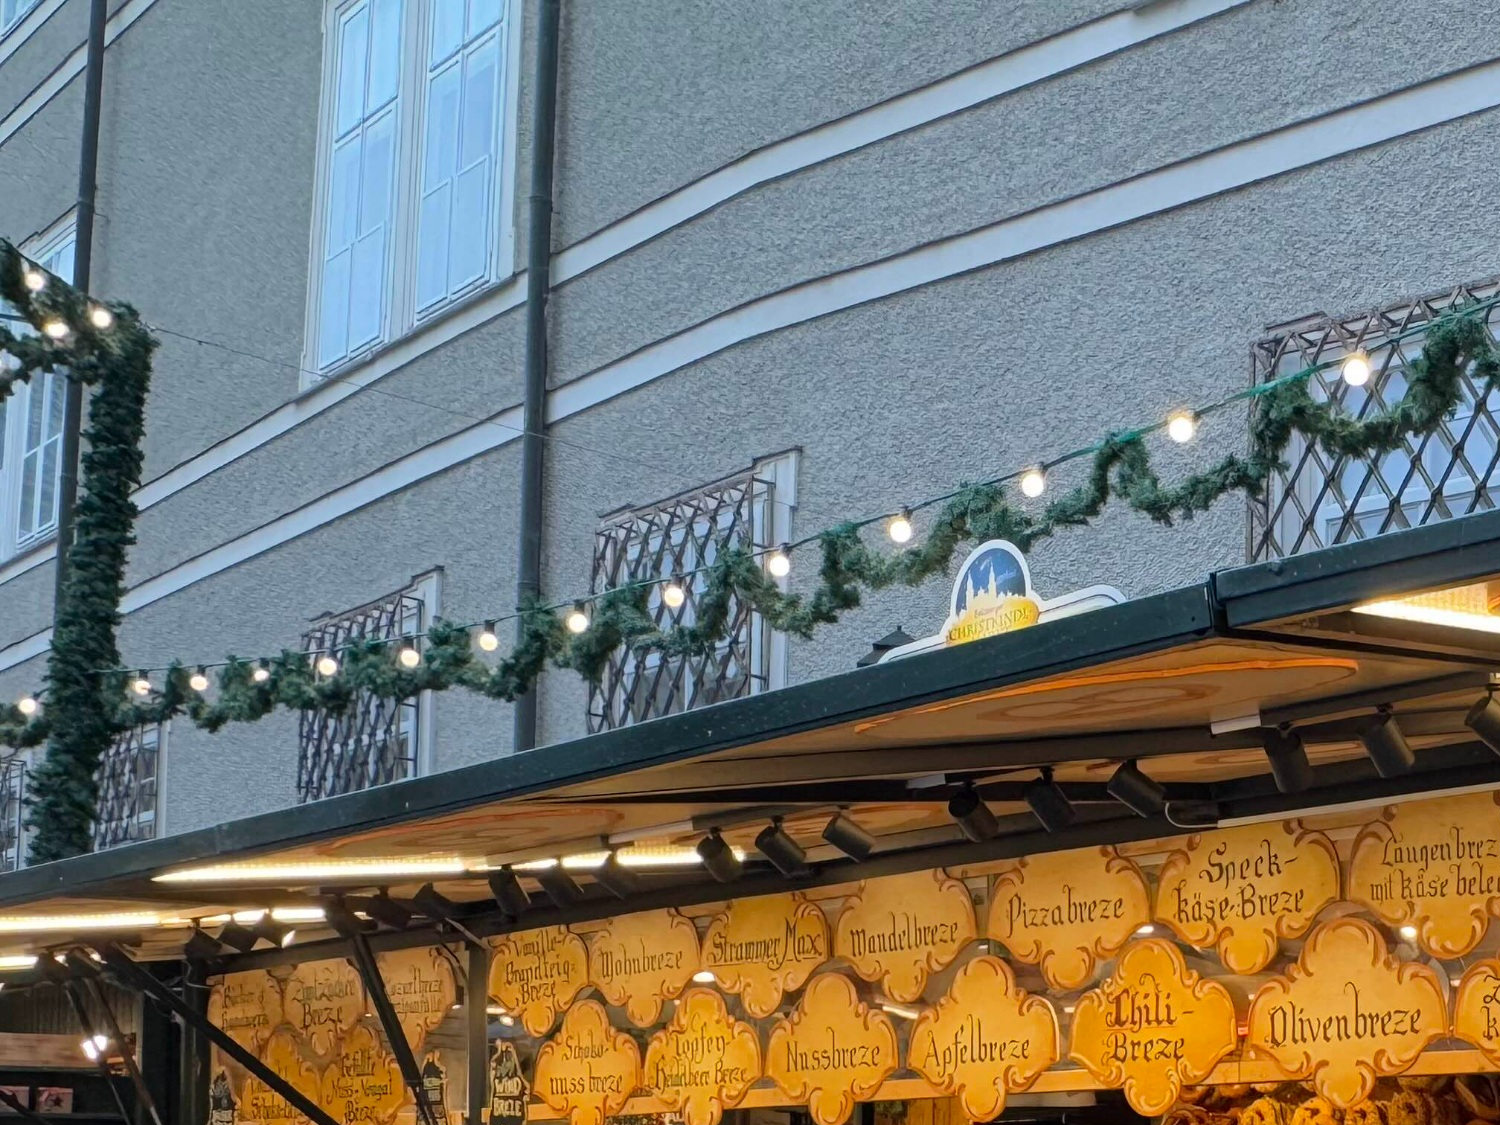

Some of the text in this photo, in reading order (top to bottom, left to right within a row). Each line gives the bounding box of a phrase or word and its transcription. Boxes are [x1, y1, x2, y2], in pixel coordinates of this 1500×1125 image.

[1370, 876, 1394, 903] mit
[768, 918, 822, 971] Max
[850, 911, 958, 957] Mandelbreze
[599, 938, 682, 984] Mohnbreze
[1265, 981, 1421, 1049] Olivenbreze
[786, 1027, 880, 1072] Nussbreze
[923, 1014, 1030, 1077] Apfelbreze
[1105, 1033, 1185, 1062] Breze
